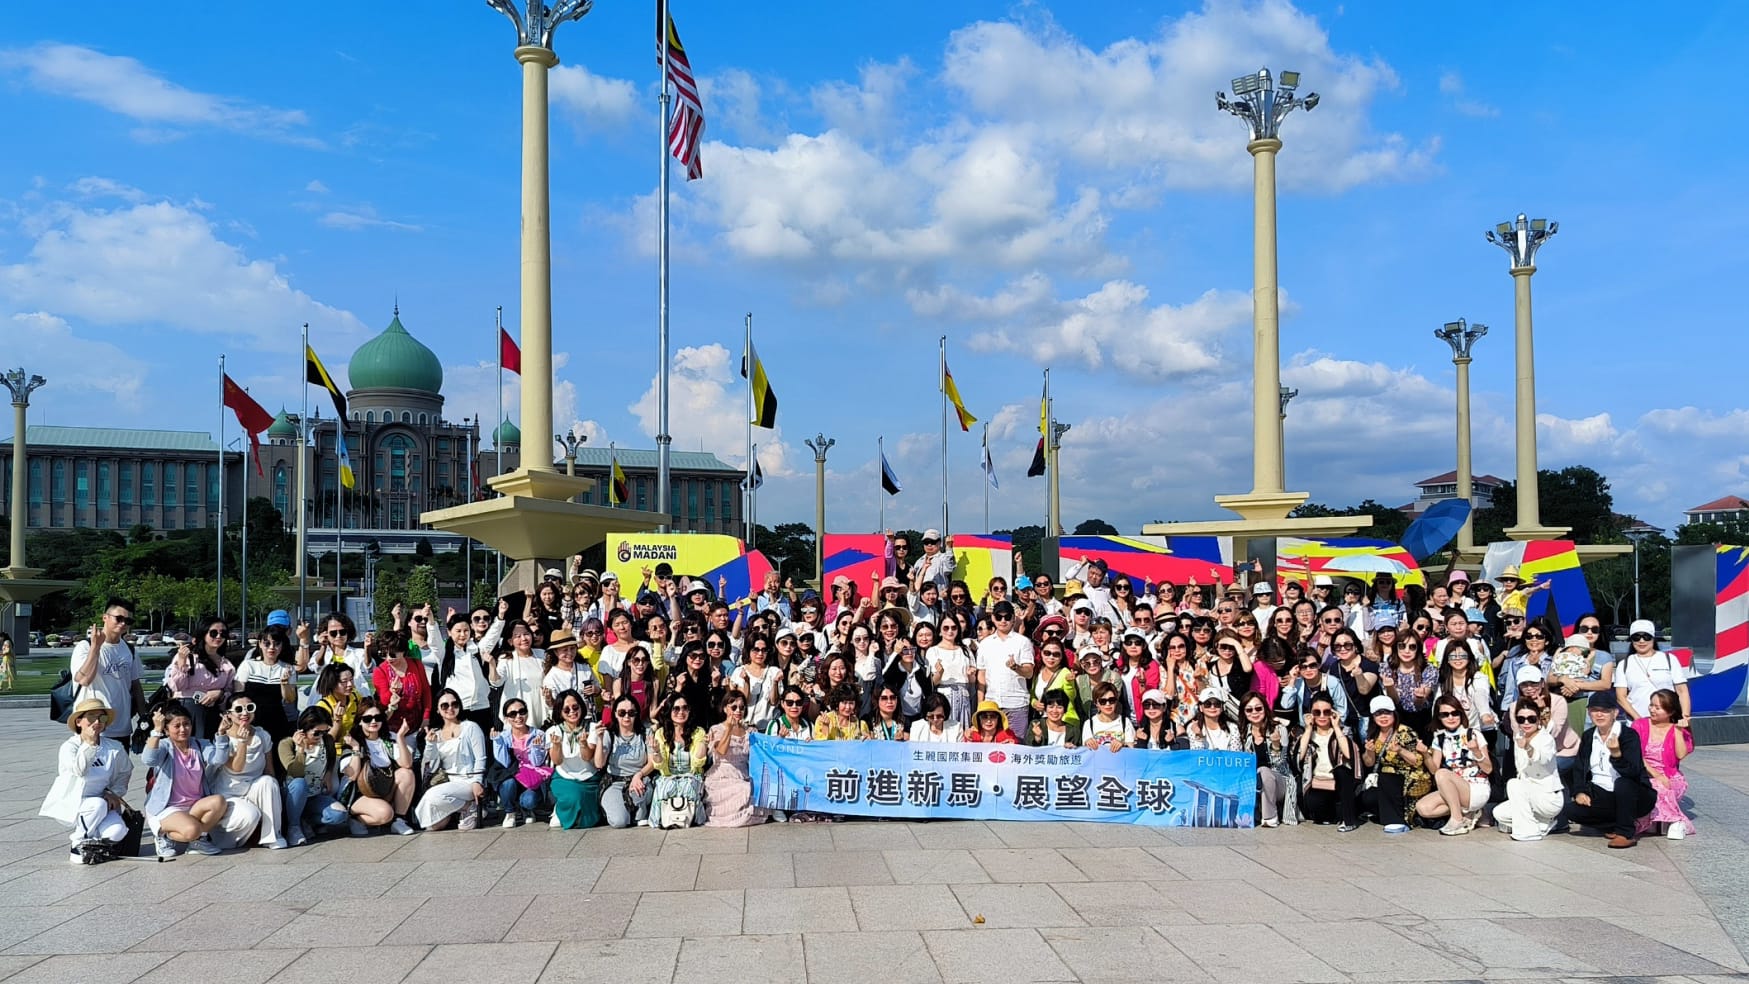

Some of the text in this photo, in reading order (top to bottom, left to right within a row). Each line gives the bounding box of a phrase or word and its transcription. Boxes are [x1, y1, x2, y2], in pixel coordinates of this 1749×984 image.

[633, 544, 677, 552] MALAYSIA
[633, 551, 677, 560] MADANI
[757, 740, 804, 754] EYOND
[912, 751, 983, 762] 生麗國際集團
[1198, 756, 1251, 768] FUTURE
